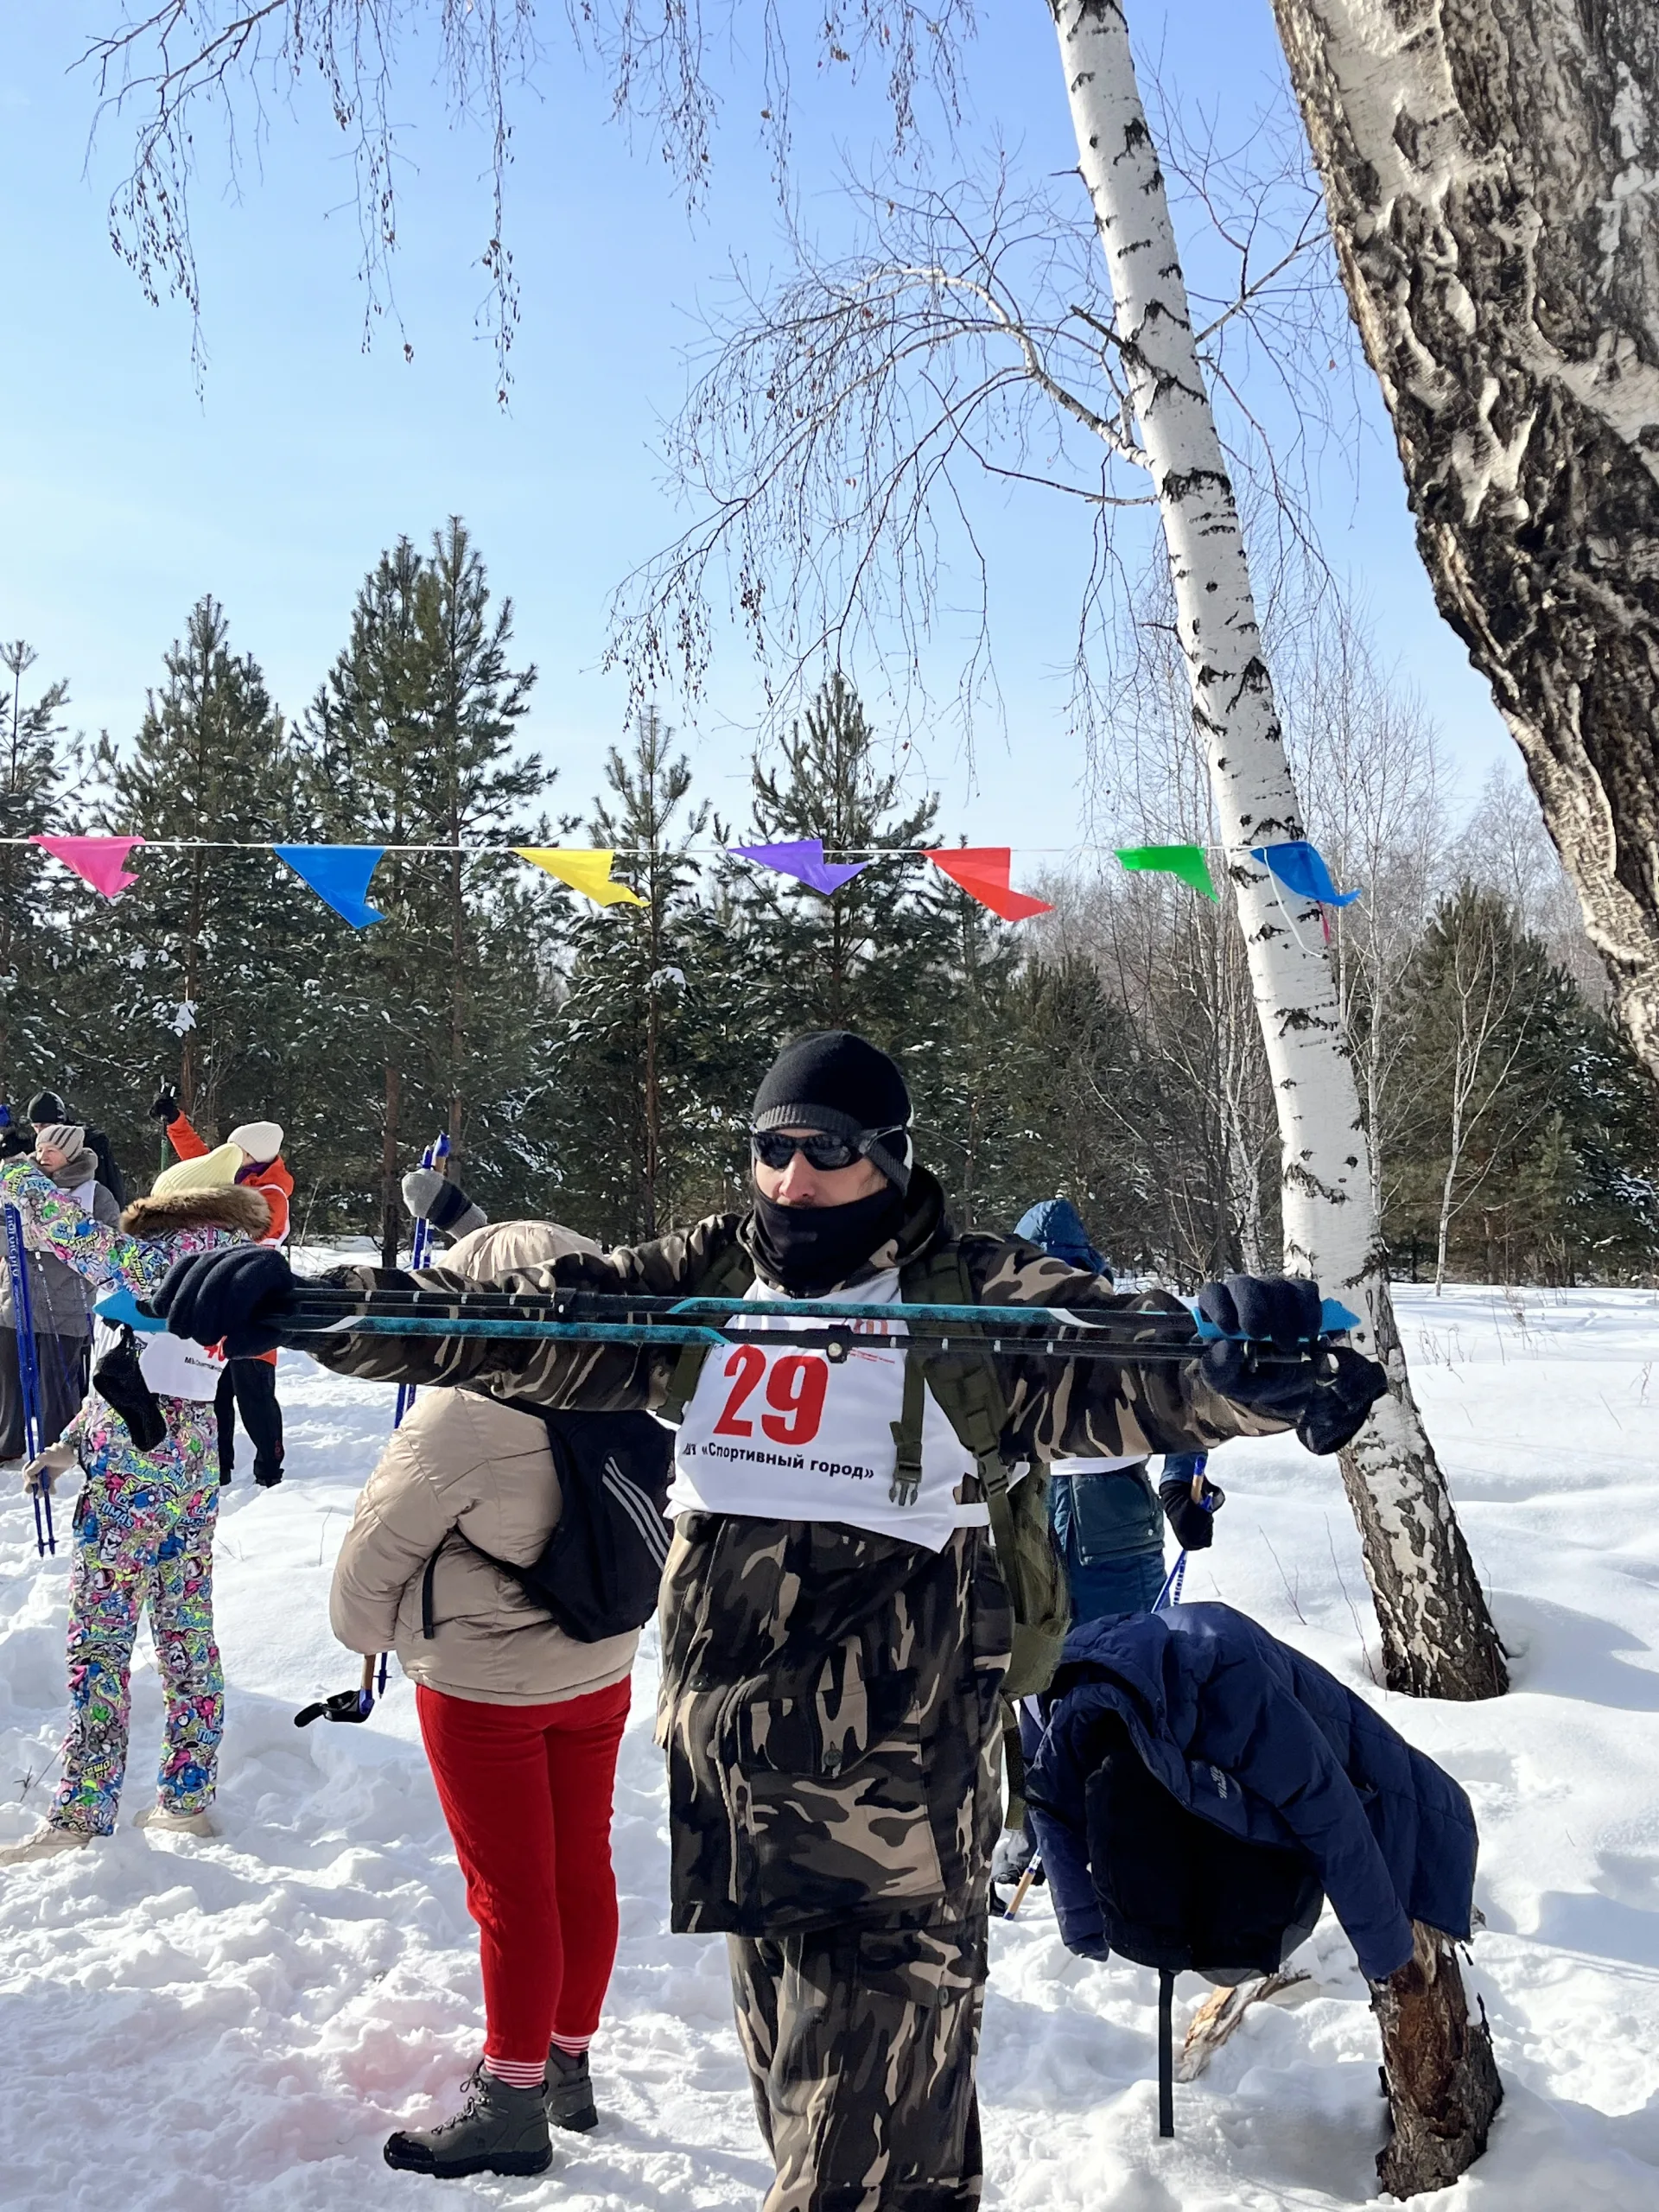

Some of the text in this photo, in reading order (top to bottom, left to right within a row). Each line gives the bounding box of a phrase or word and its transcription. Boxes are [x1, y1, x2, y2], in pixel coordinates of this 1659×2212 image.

[713, 1344, 829, 1446] 29
[701, 1441, 804, 1470] «Спортивный
[810, 1459, 874, 1480] город»
